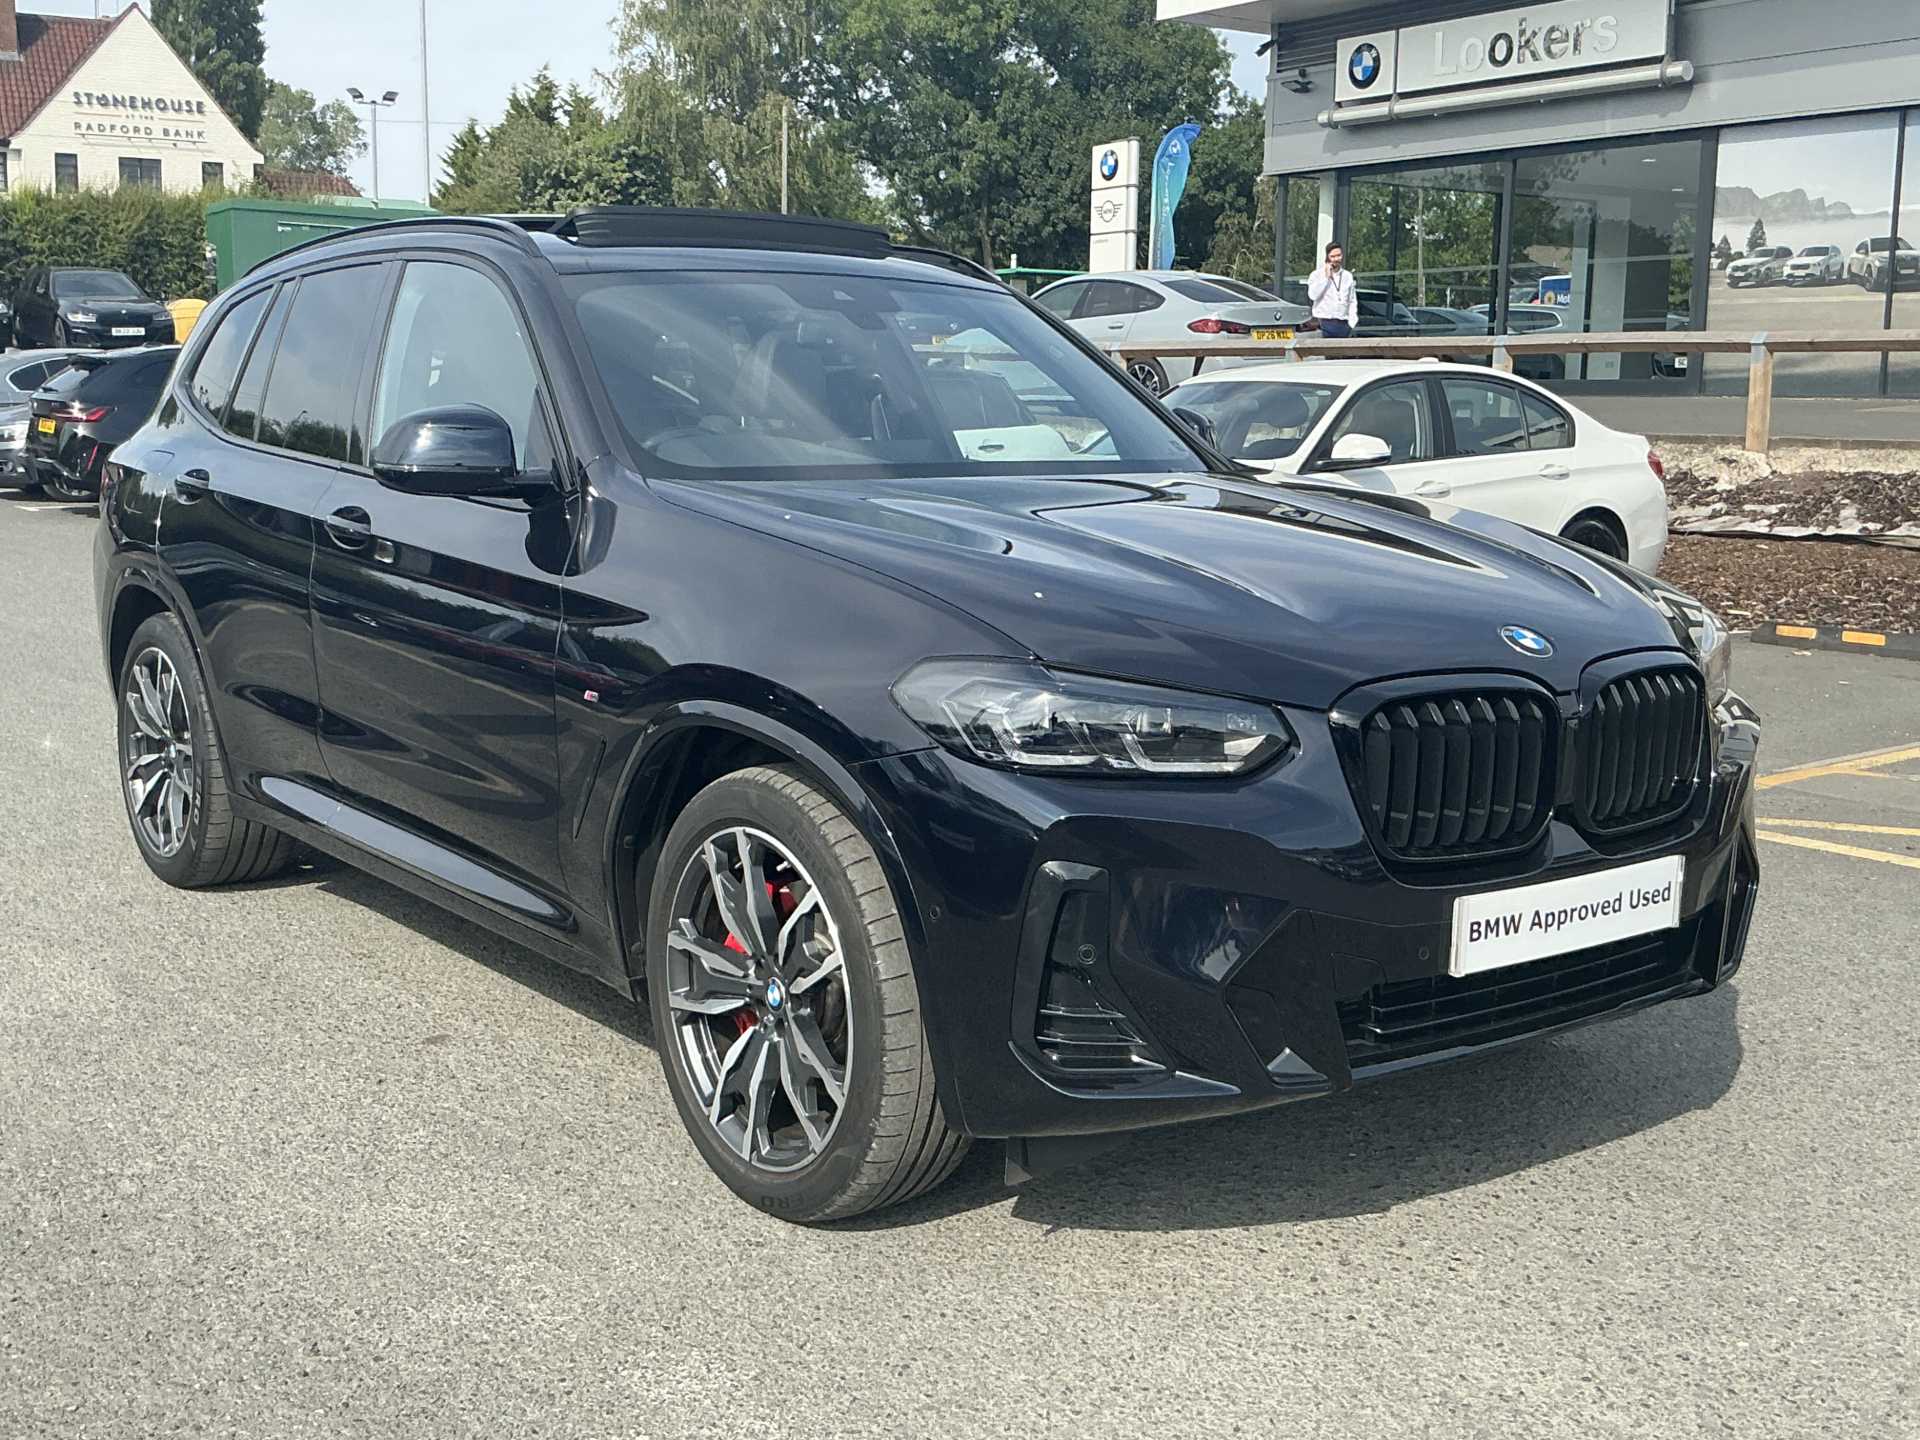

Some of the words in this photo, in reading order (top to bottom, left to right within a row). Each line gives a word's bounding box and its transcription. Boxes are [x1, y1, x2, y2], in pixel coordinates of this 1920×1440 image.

[1432, 15, 1618, 76] Lookers
[73, 91, 206, 114] STONEHOUSE
[73, 121, 153, 136] RADFORD
[162, 127, 206, 139] BANK
[1468, 912, 1523, 943] BMW
[1529, 891, 1623, 933] Approved
[1628, 880, 1672, 910] Used
